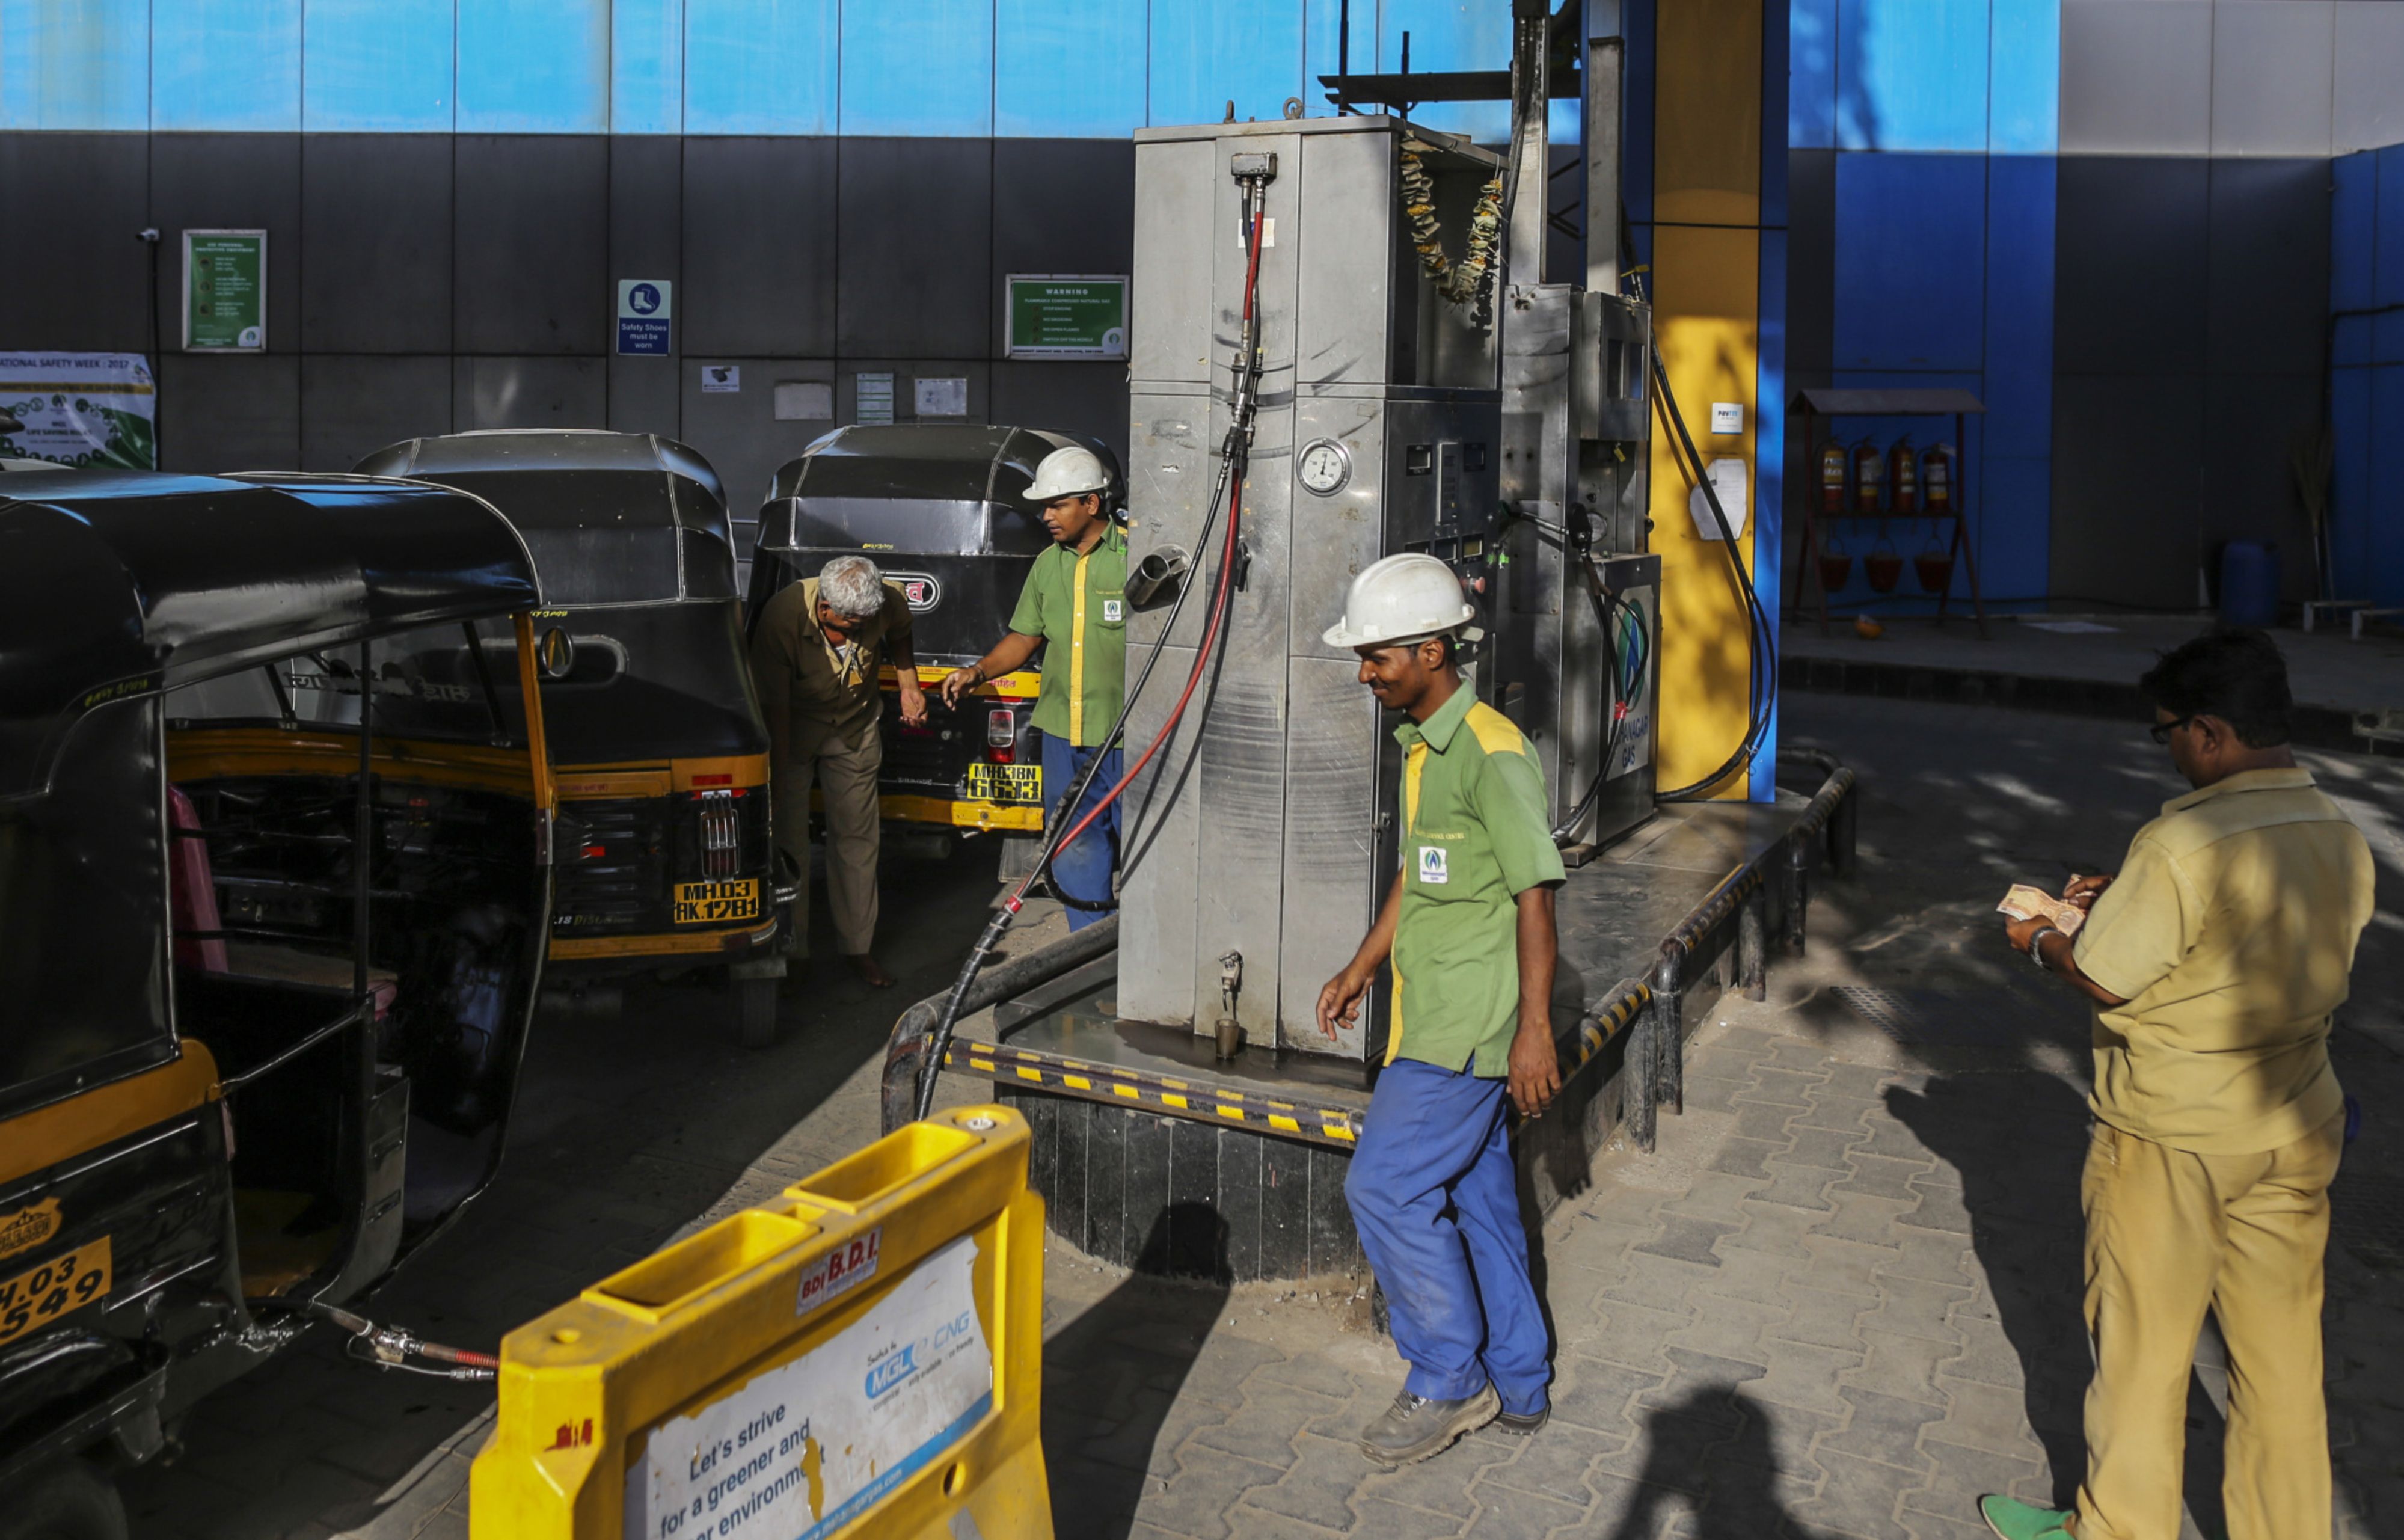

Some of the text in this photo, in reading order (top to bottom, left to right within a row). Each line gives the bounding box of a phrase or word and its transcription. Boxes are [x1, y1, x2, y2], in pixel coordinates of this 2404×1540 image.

[621, 324, 643, 332] Safety
[40, 359, 72, 368] SAFETY
[75, 360, 100, 368] WEEK
[107, 360, 129, 368] 2017
[684, 882, 750, 901] MH.03
[802, 1272, 825, 1299] BDI
[872, 1352, 911, 1394] MGL
[934, 1309, 970, 1350] CNG
[689, 1403, 786, 1483] Let's strive
[660, 1511, 687, 1539] for
[691, 1497, 703, 1518] a
[707, 1446, 776, 1512] greener
[780, 1417, 810, 1452] and
[718, 1443, 826, 1536] environmet
